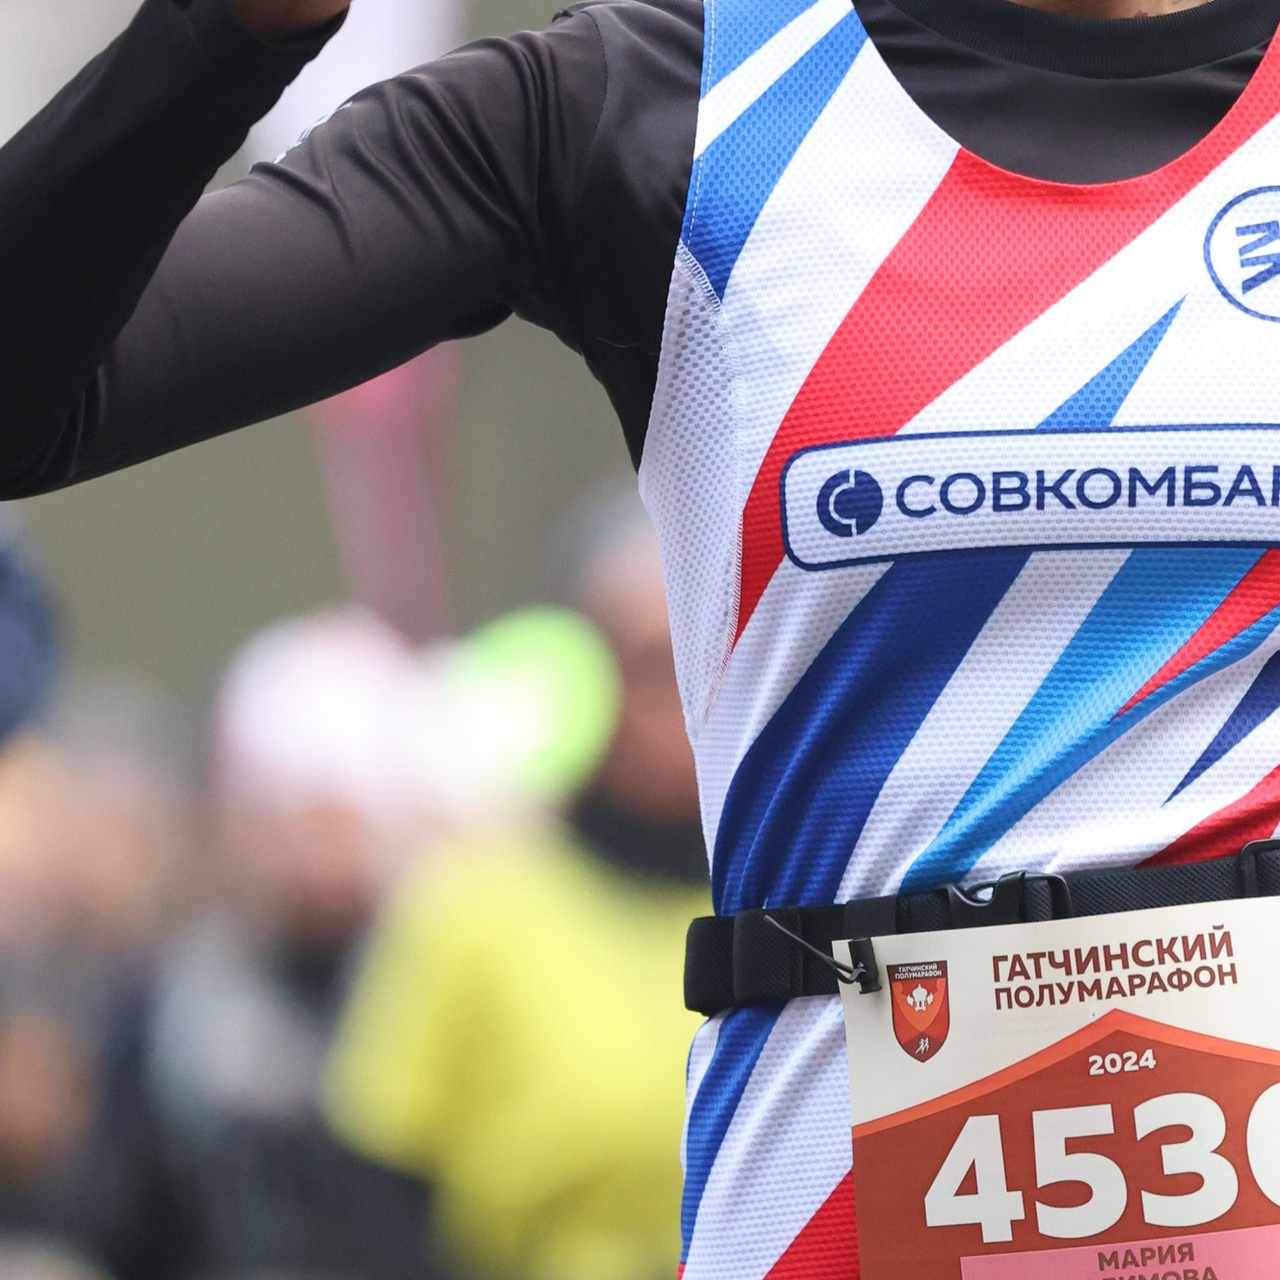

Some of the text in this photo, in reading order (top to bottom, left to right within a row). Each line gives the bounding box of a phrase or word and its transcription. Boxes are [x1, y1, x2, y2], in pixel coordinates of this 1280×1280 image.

[992, 924, 1235, 983] ГАТЧИНСКИЙ
[894, 970, 942, 979] ПОЛУМАРАФОН
[898, 963, 938, 973] ГАТЧИНСКИЙ
[995, 963, 1238, 1010] ПОЛУМАРАФОН
[1090, 1050, 1156, 1076] 2024
[1098, 1243, 1195, 1271] МАРИЯ
